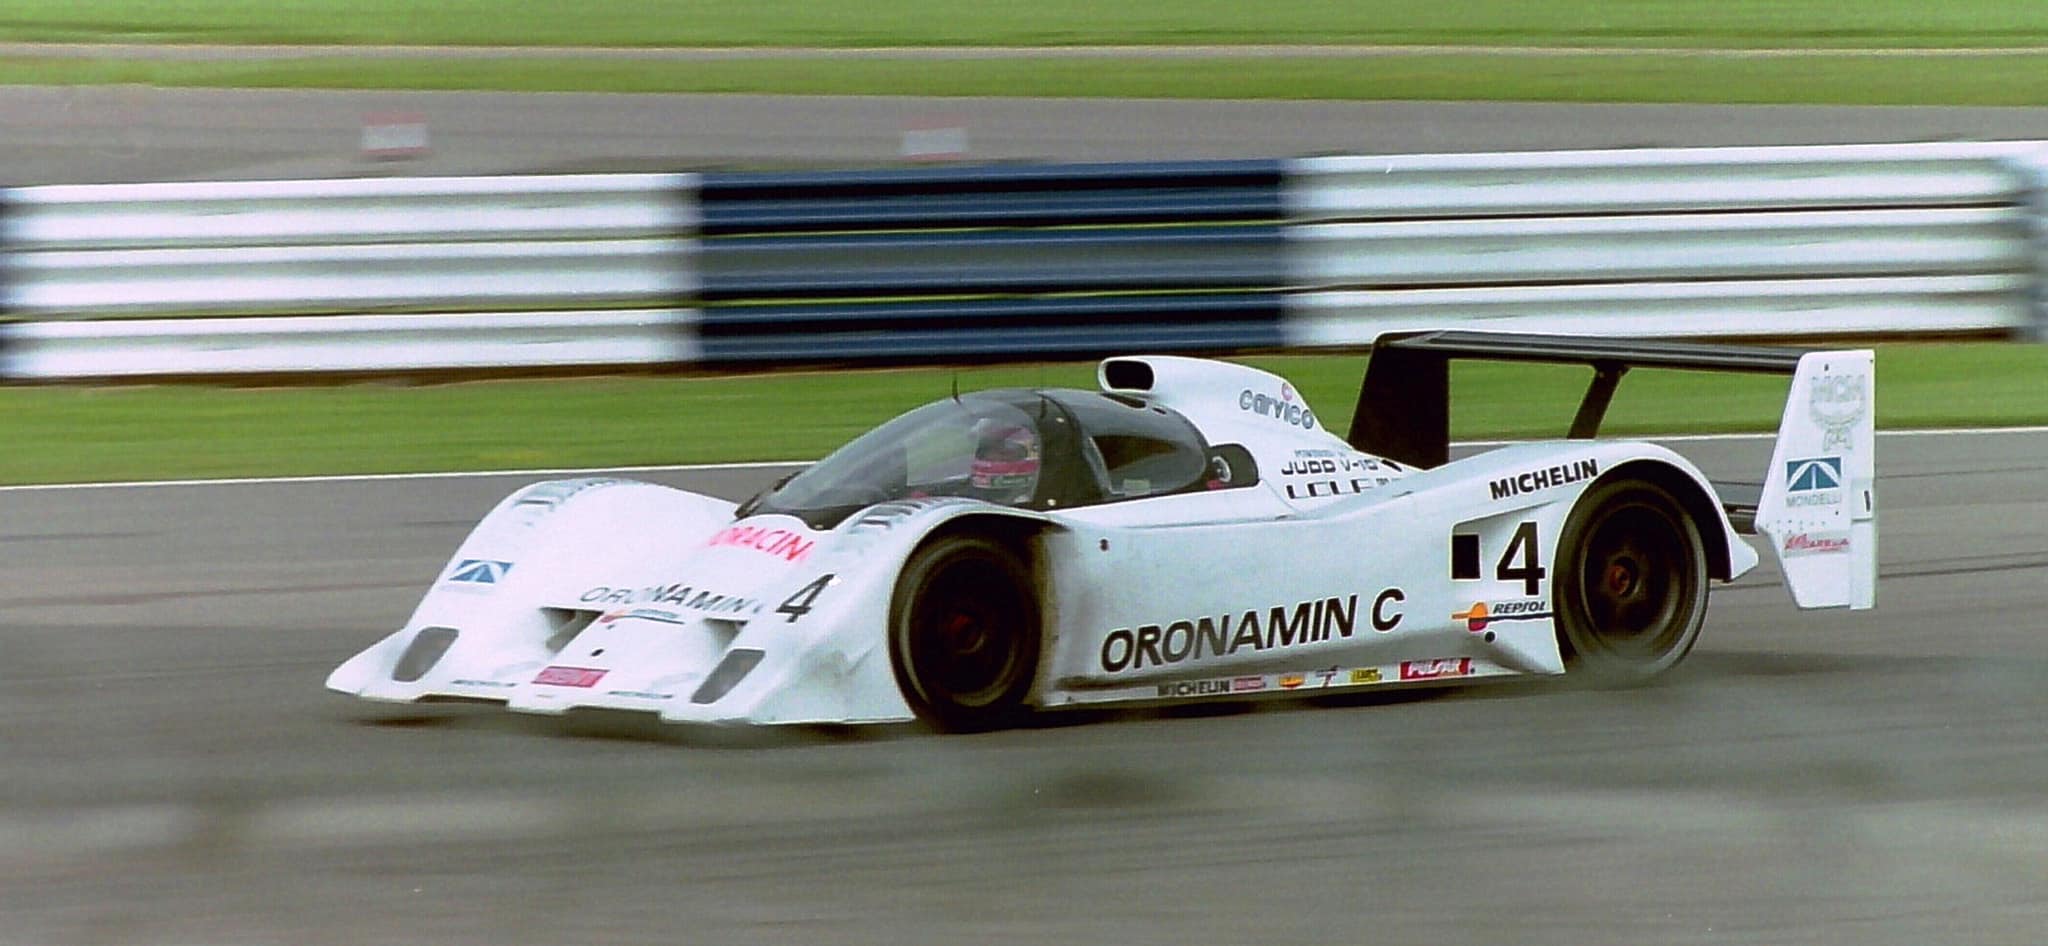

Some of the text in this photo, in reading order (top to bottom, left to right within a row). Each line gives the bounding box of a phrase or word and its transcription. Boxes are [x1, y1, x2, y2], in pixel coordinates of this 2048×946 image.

[1239, 389, 1315, 430] carvico
[1281, 459, 1337, 476] JUDD
[1489, 458, 1598, 500] MICHELIN
[1496, 521, 1546, 596] 4
[775, 573, 835, 623] 4
[1492, 601, 1546, 615] REPSOL
[1101, 587, 1405, 673] ORONAMIN C
[1157, 680, 1230, 697] MICHELIN
